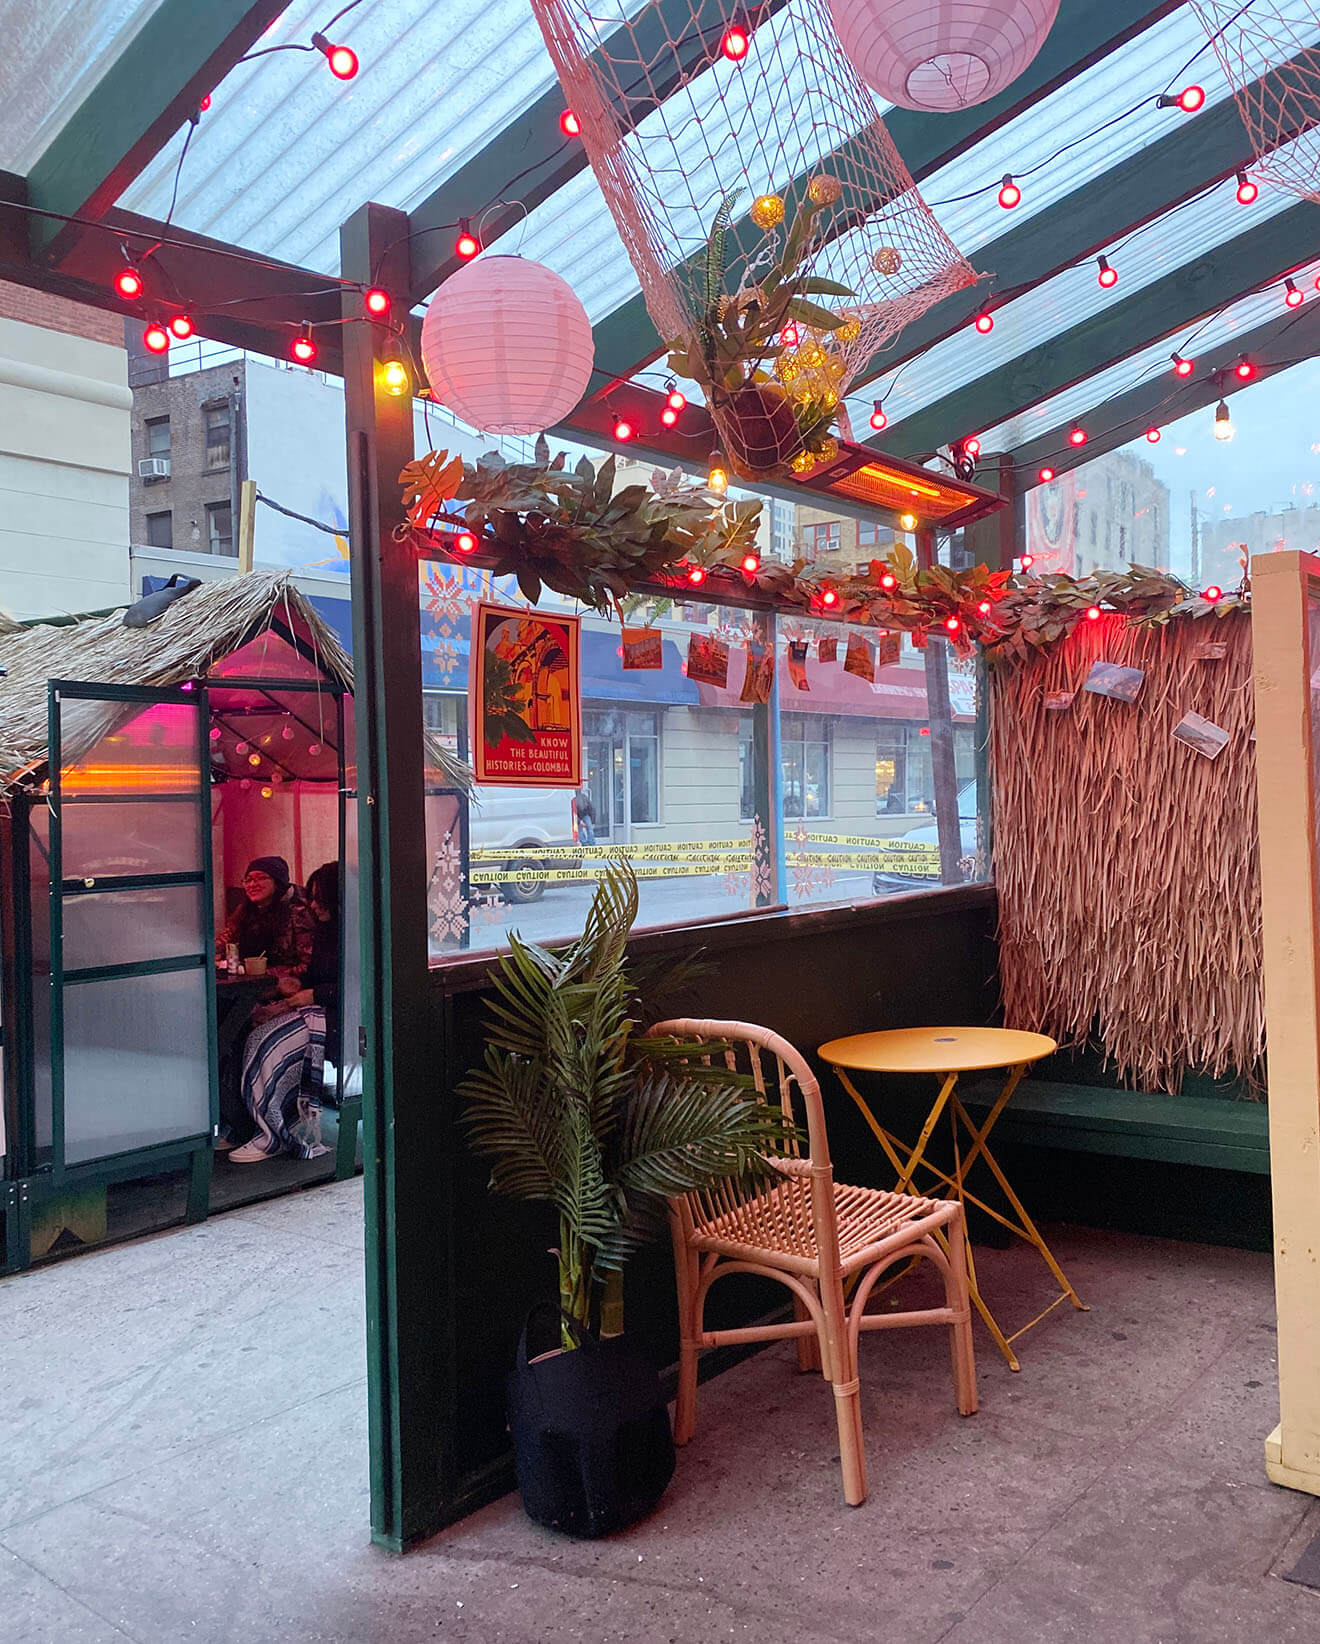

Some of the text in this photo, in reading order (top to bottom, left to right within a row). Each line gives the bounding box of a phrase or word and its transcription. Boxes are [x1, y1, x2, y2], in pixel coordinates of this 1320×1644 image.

[541, 737, 568, 748] KNOW
[510, 748, 568, 760] THE BEAUTIFUL
[486, 759, 526, 771] HISTORIES
[533, 761, 570, 773] COLOMBIA
[827, 854, 852, 863] CAUTION
[856, 854, 880, 863] CAUTION
